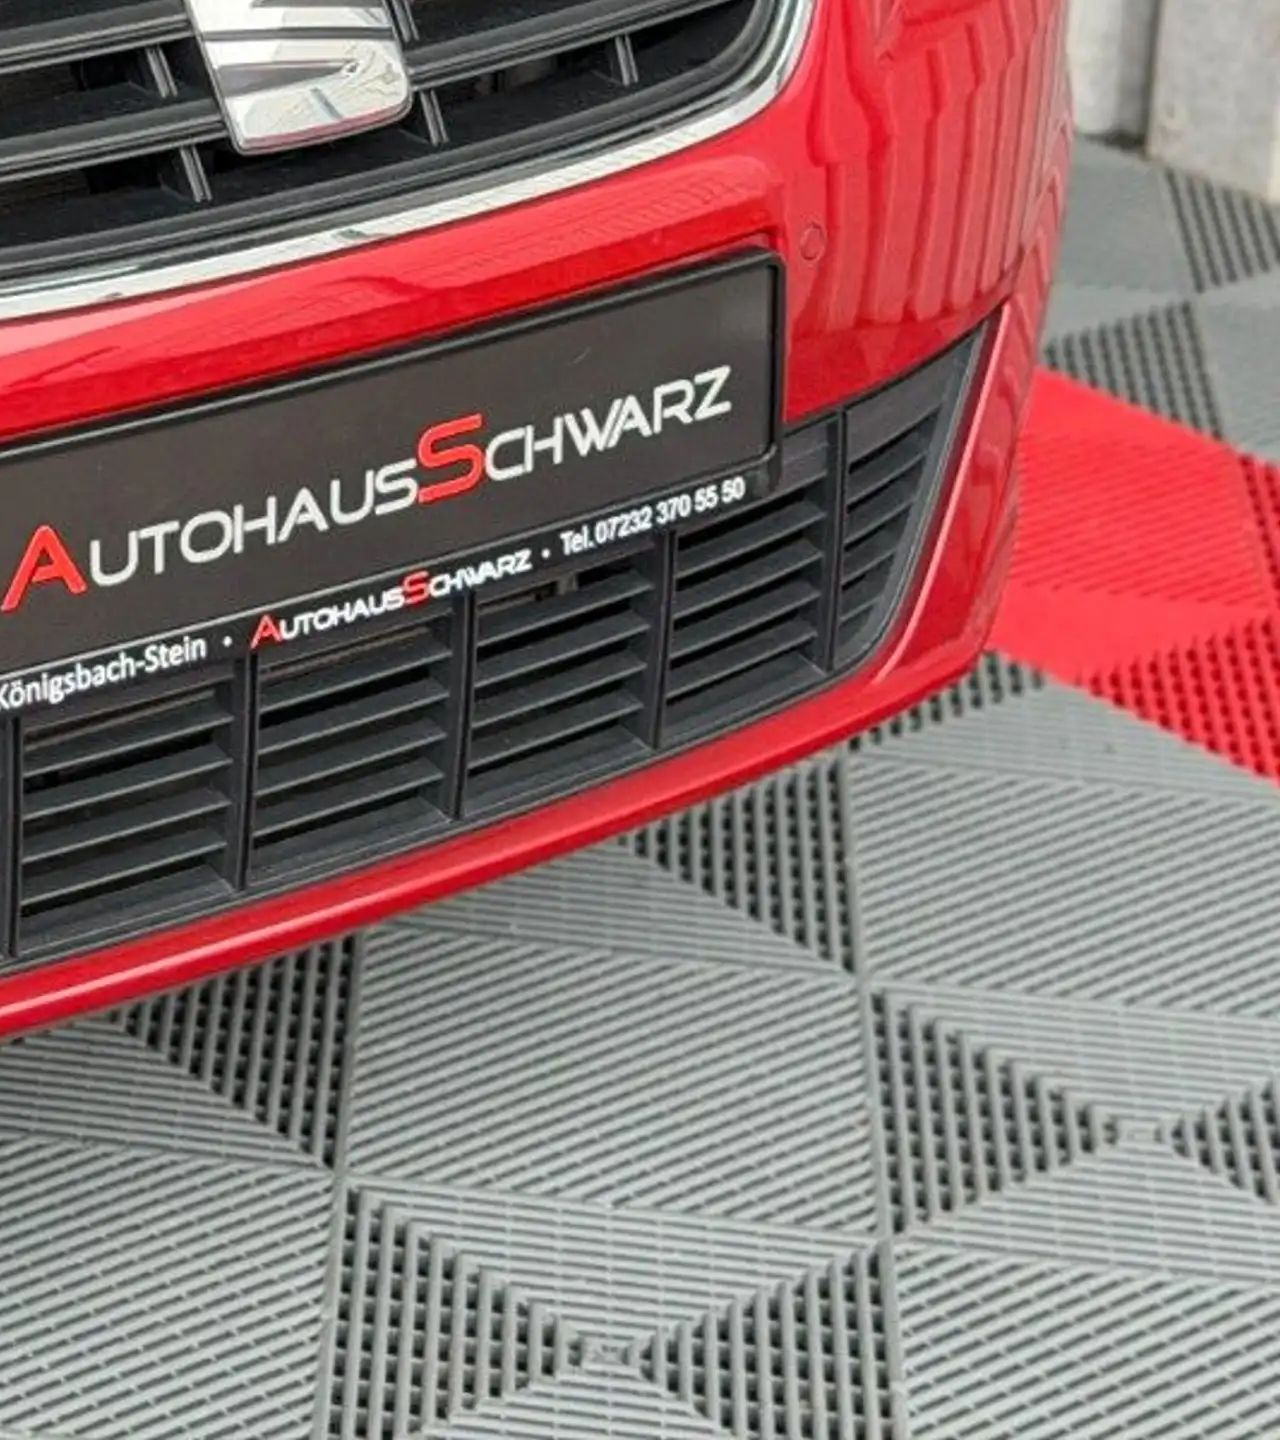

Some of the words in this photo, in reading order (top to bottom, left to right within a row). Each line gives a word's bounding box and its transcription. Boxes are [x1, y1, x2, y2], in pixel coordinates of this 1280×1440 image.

[656, 494, 690, 524] 370
[694, 484, 718, 511] 55
[721, 476, 746, 503] 50
